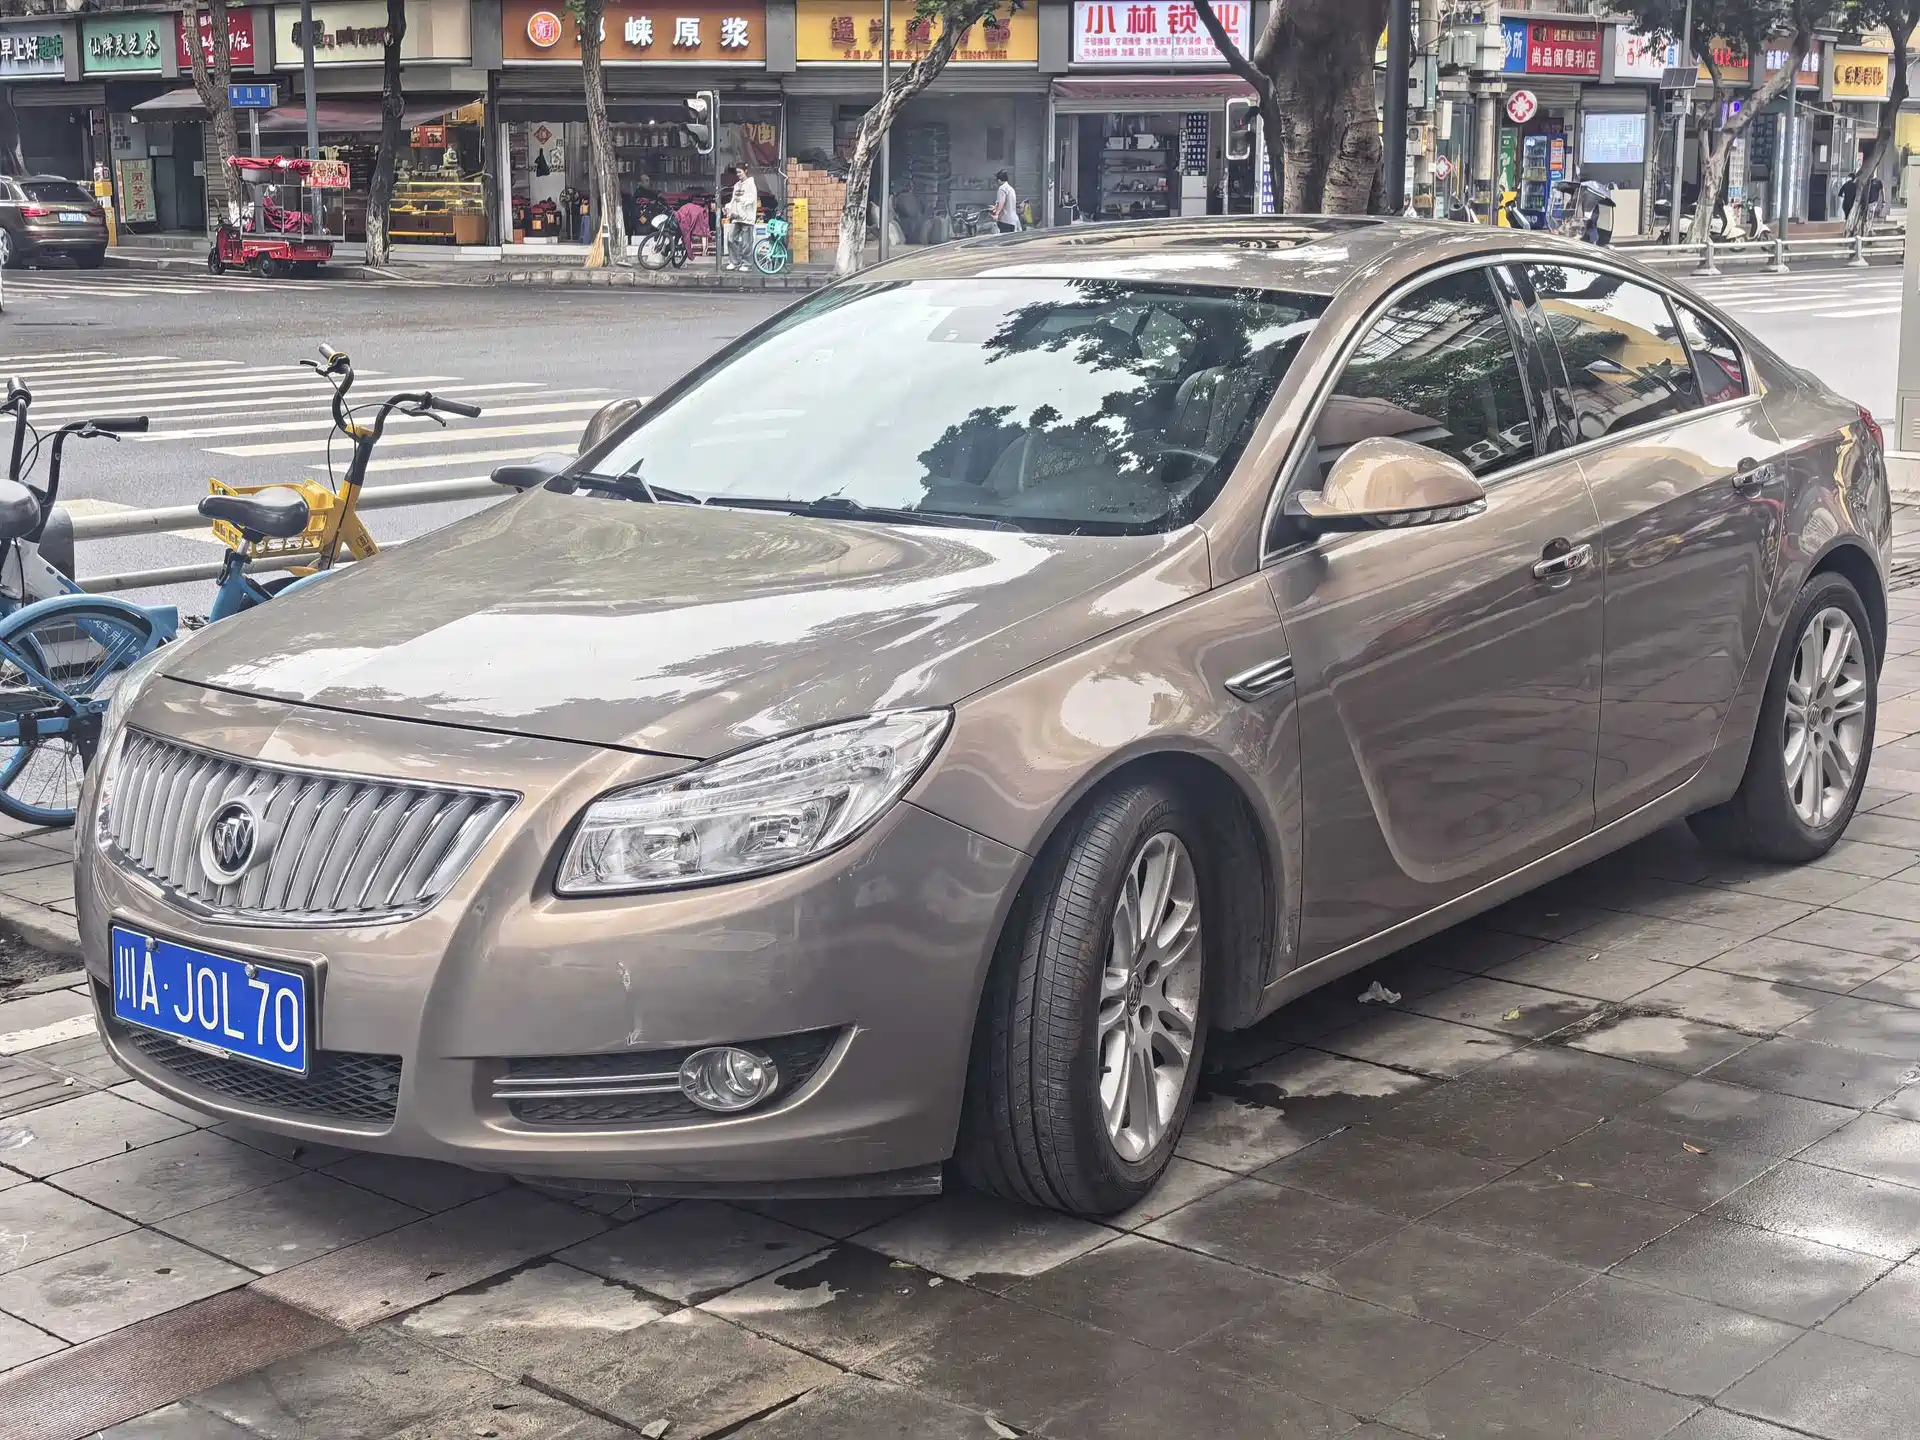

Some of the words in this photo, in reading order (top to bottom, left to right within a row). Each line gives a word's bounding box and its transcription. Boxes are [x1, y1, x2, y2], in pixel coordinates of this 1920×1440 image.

[576, 16, 750, 48] 崃原浆
[1085, 4, 1239, 34] 小林锁业
[1531, 46, 1597, 69] 尚品阁便利店
